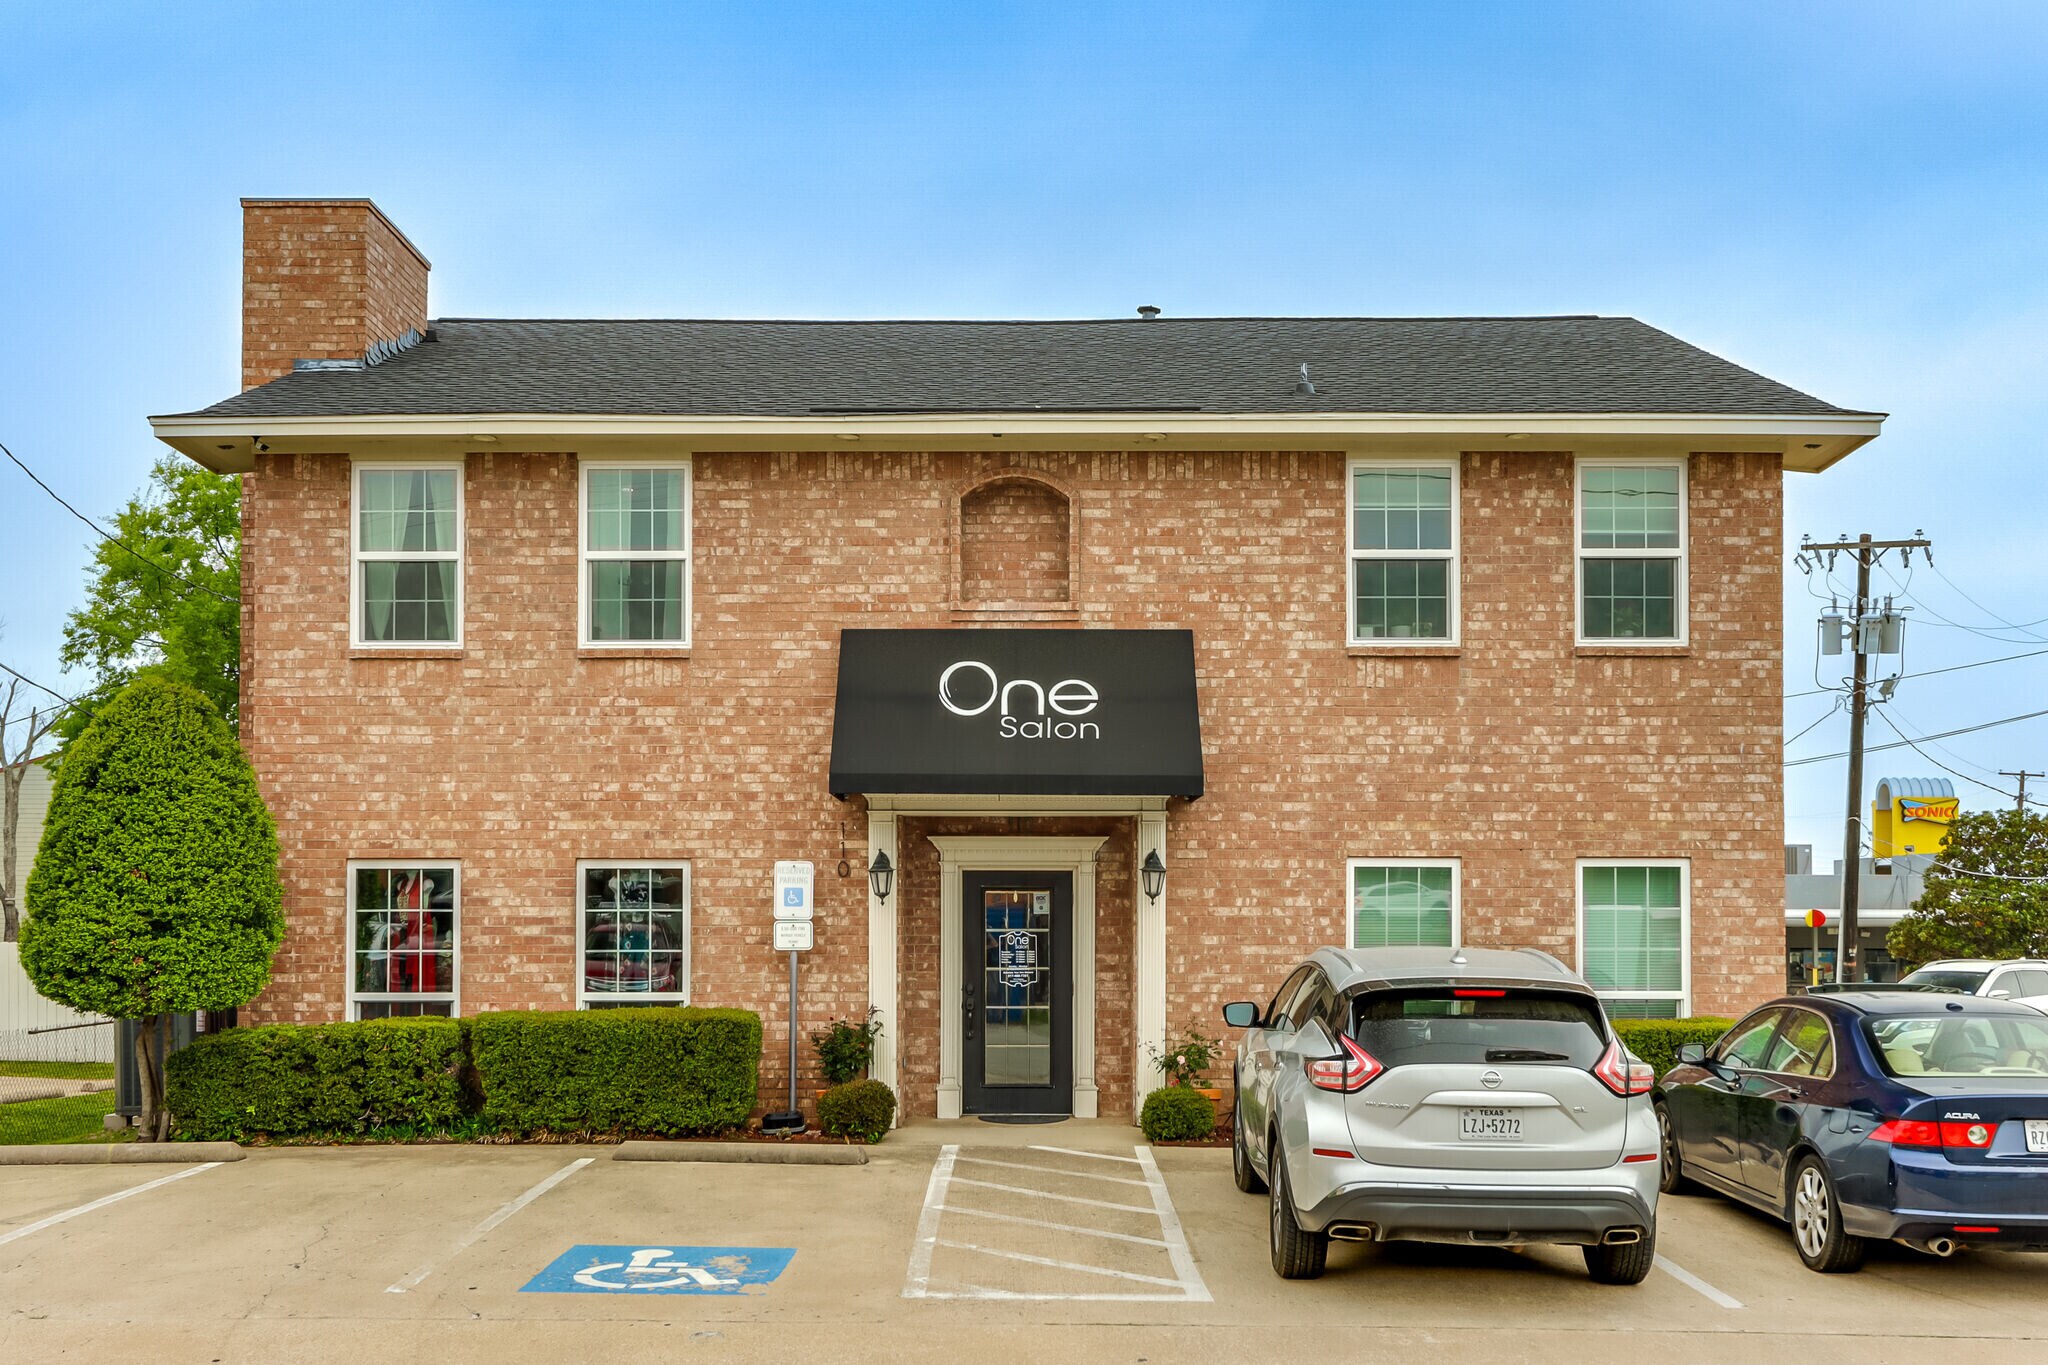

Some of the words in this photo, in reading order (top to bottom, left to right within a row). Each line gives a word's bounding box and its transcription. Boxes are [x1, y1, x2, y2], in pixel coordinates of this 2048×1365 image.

[938, 660, 1099, 716] One
[999, 716, 1100, 739] Salon
[1906, 806, 1953, 818] SONIC
[1007, 935, 1029, 945] One
